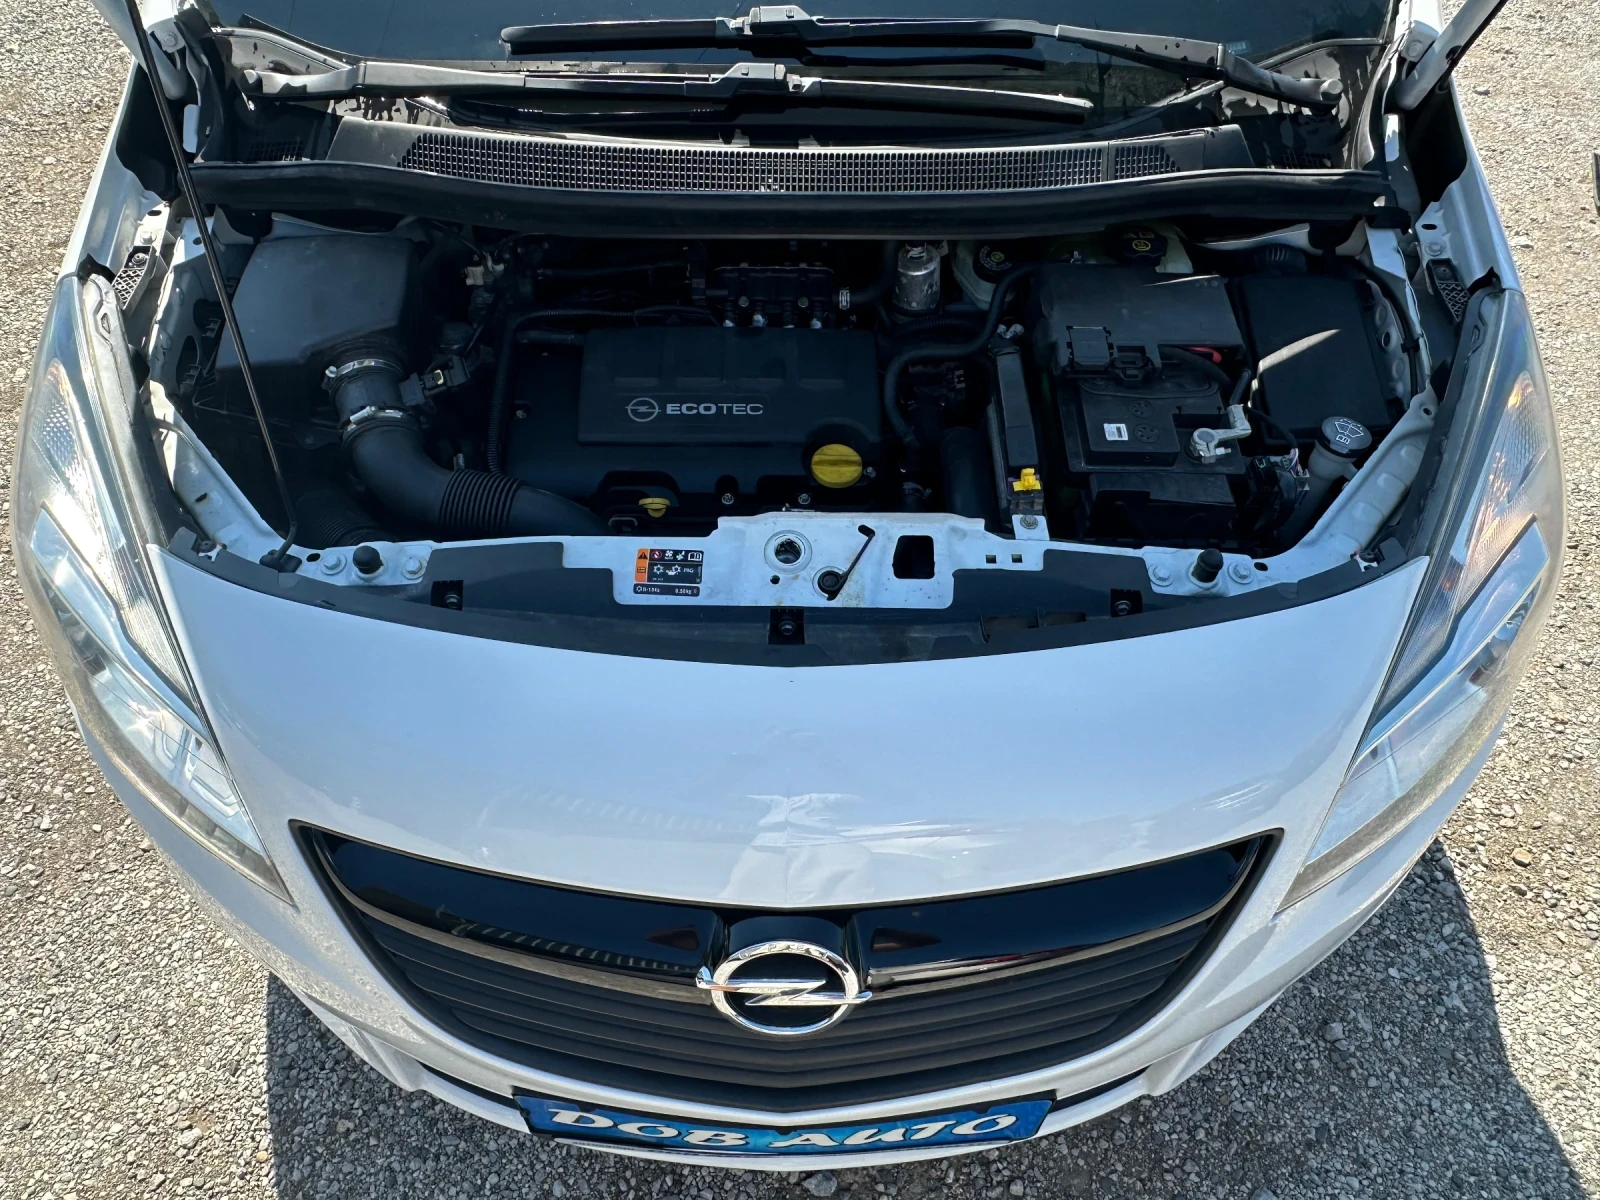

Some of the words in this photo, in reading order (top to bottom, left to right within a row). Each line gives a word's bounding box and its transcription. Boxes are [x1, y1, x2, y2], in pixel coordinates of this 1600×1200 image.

[666, 403, 764, 415] ECOTEC
[547, 1108, 750, 1147] DOB
[768, 1113, 1018, 1148] AUTO
